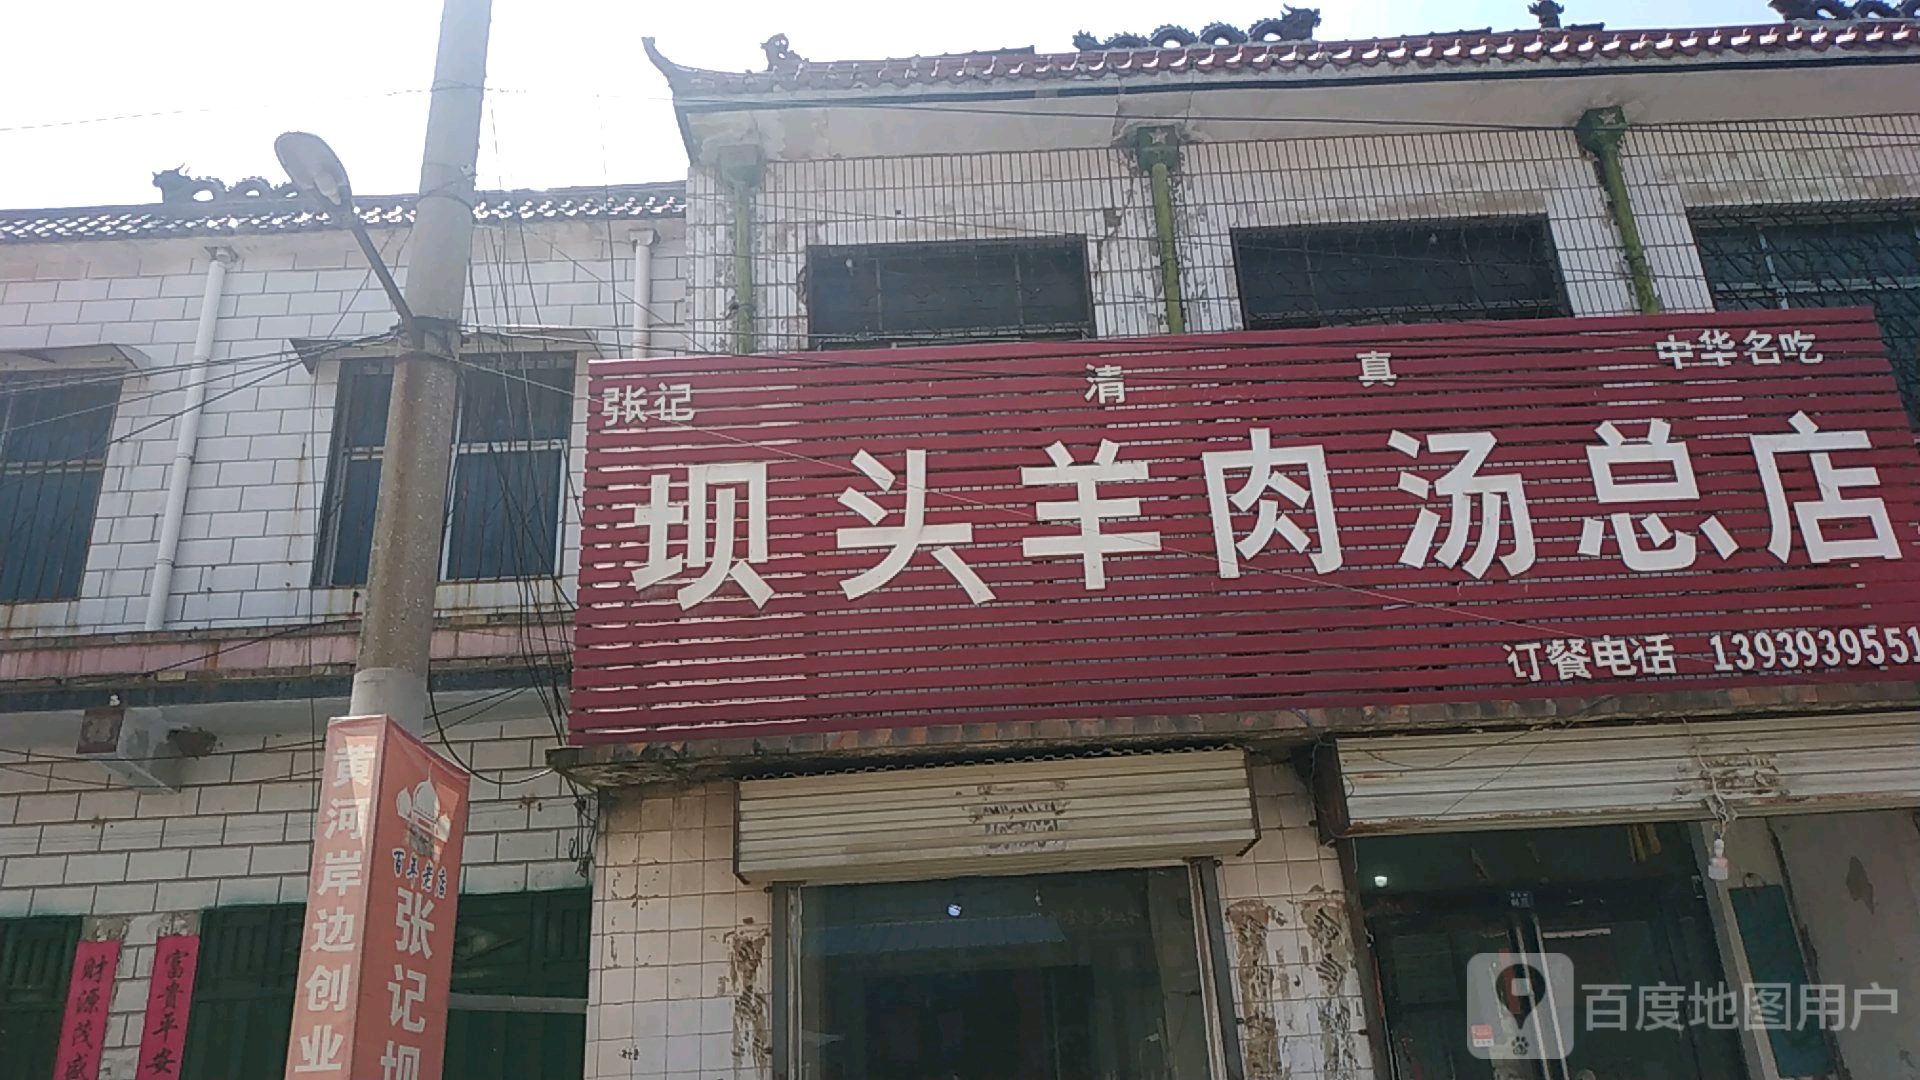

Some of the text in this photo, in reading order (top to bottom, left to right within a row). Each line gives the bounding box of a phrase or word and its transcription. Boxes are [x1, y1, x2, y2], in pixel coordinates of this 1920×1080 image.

[1084, 350, 1397, 404] 清 真
[1655, 328, 1824, 369] 中华名吃
[600, 382, 696, 427] 张记
[631, 410, 1903, 611] 坝头羊肉汤总店
[1503, 626, 1920, 683] 订餐电话 1393939551
[294, 743, 377, 1073] 黄河岸边创业
[380, 886, 436, 1080] 张记坝
